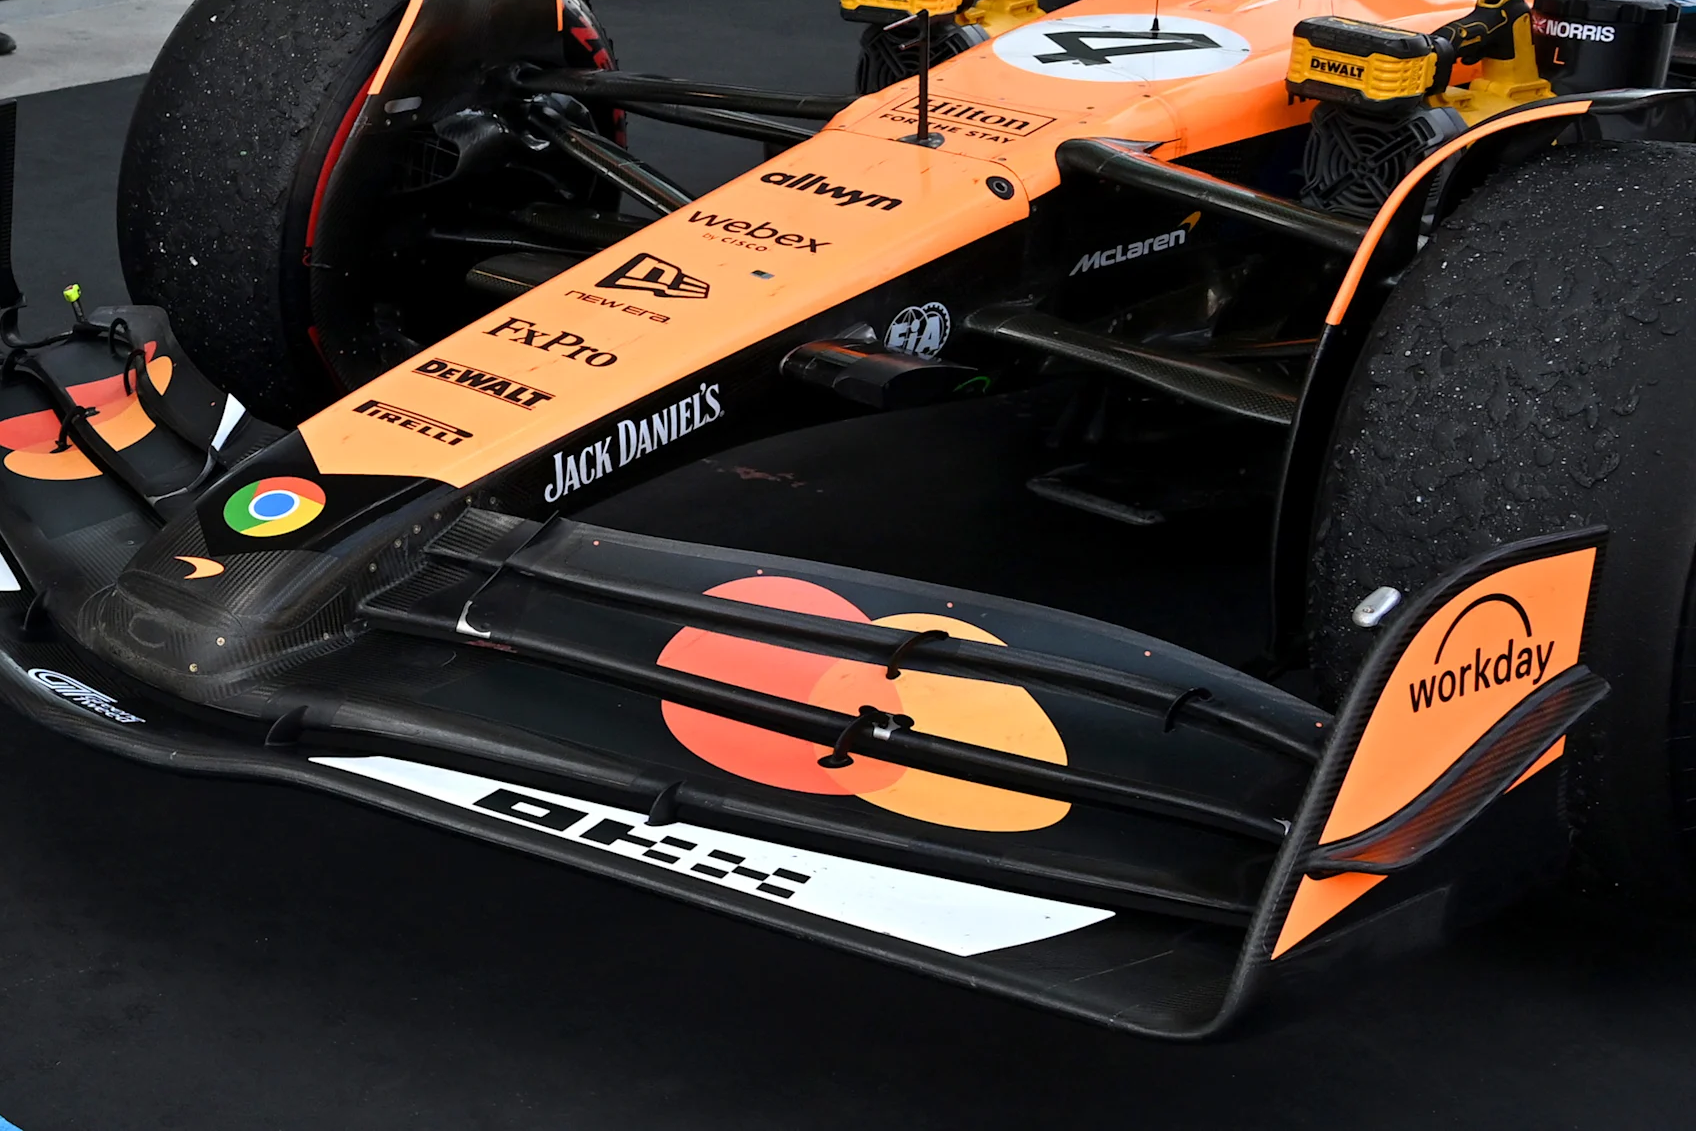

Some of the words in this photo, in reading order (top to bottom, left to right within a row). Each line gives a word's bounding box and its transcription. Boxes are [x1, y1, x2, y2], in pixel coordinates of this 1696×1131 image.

[1033, 30, 1222, 66] 4
[1546, 19, 1616, 43] NORRIS
[1553, 47, 1565, 65] L
[879, 113, 918, 125] FOR
[928, 120, 963, 134] THE
[965, 129, 1016, 144] STAY
[912, 98, 1031, 132] Hilton
[760, 171, 904, 213] allwyn
[688, 209, 832, 255] webex
[702, 231, 718, 241] by
[1069, 229, 1186, 277] McLaren
[482, 316, 618, 368] FxPro
[352, 399, 474, 446] PIRELLI
[544, 435, 615, 504] JACK
[618, 382, 724, 468] DANIEL'S
[1409, 638, 1556, 714] workday
